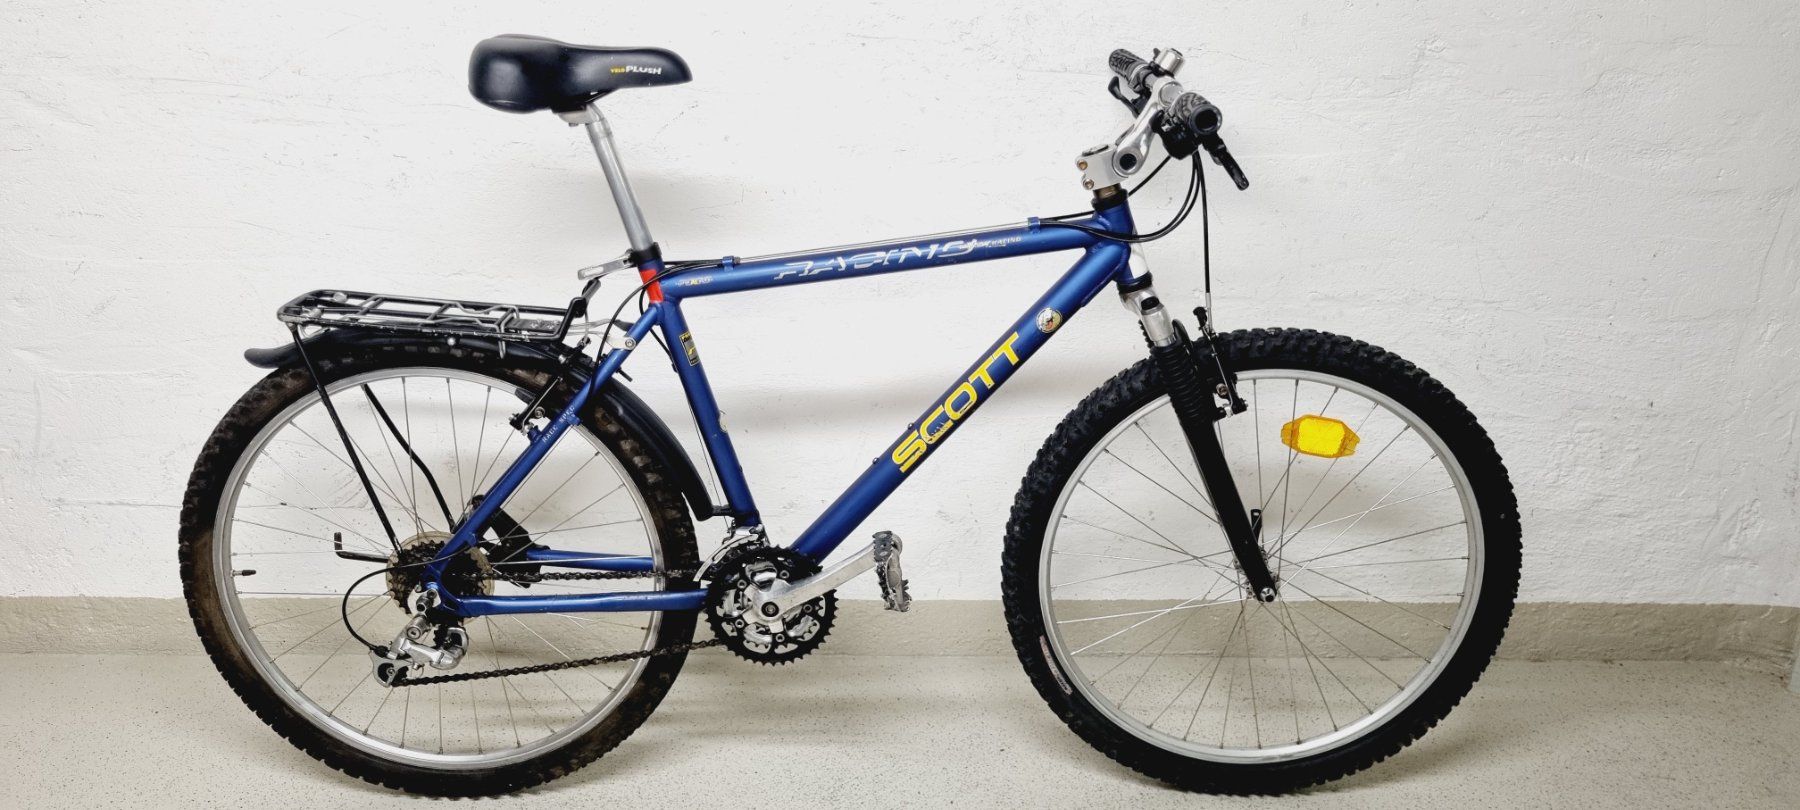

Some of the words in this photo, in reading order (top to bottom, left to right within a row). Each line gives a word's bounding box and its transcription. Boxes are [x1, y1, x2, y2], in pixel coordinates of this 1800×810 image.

[626, 65, 662, 75] PLUSH
[773, 239, 977, 280] RACING
[891, 331, 1020, 473] SCOTT
